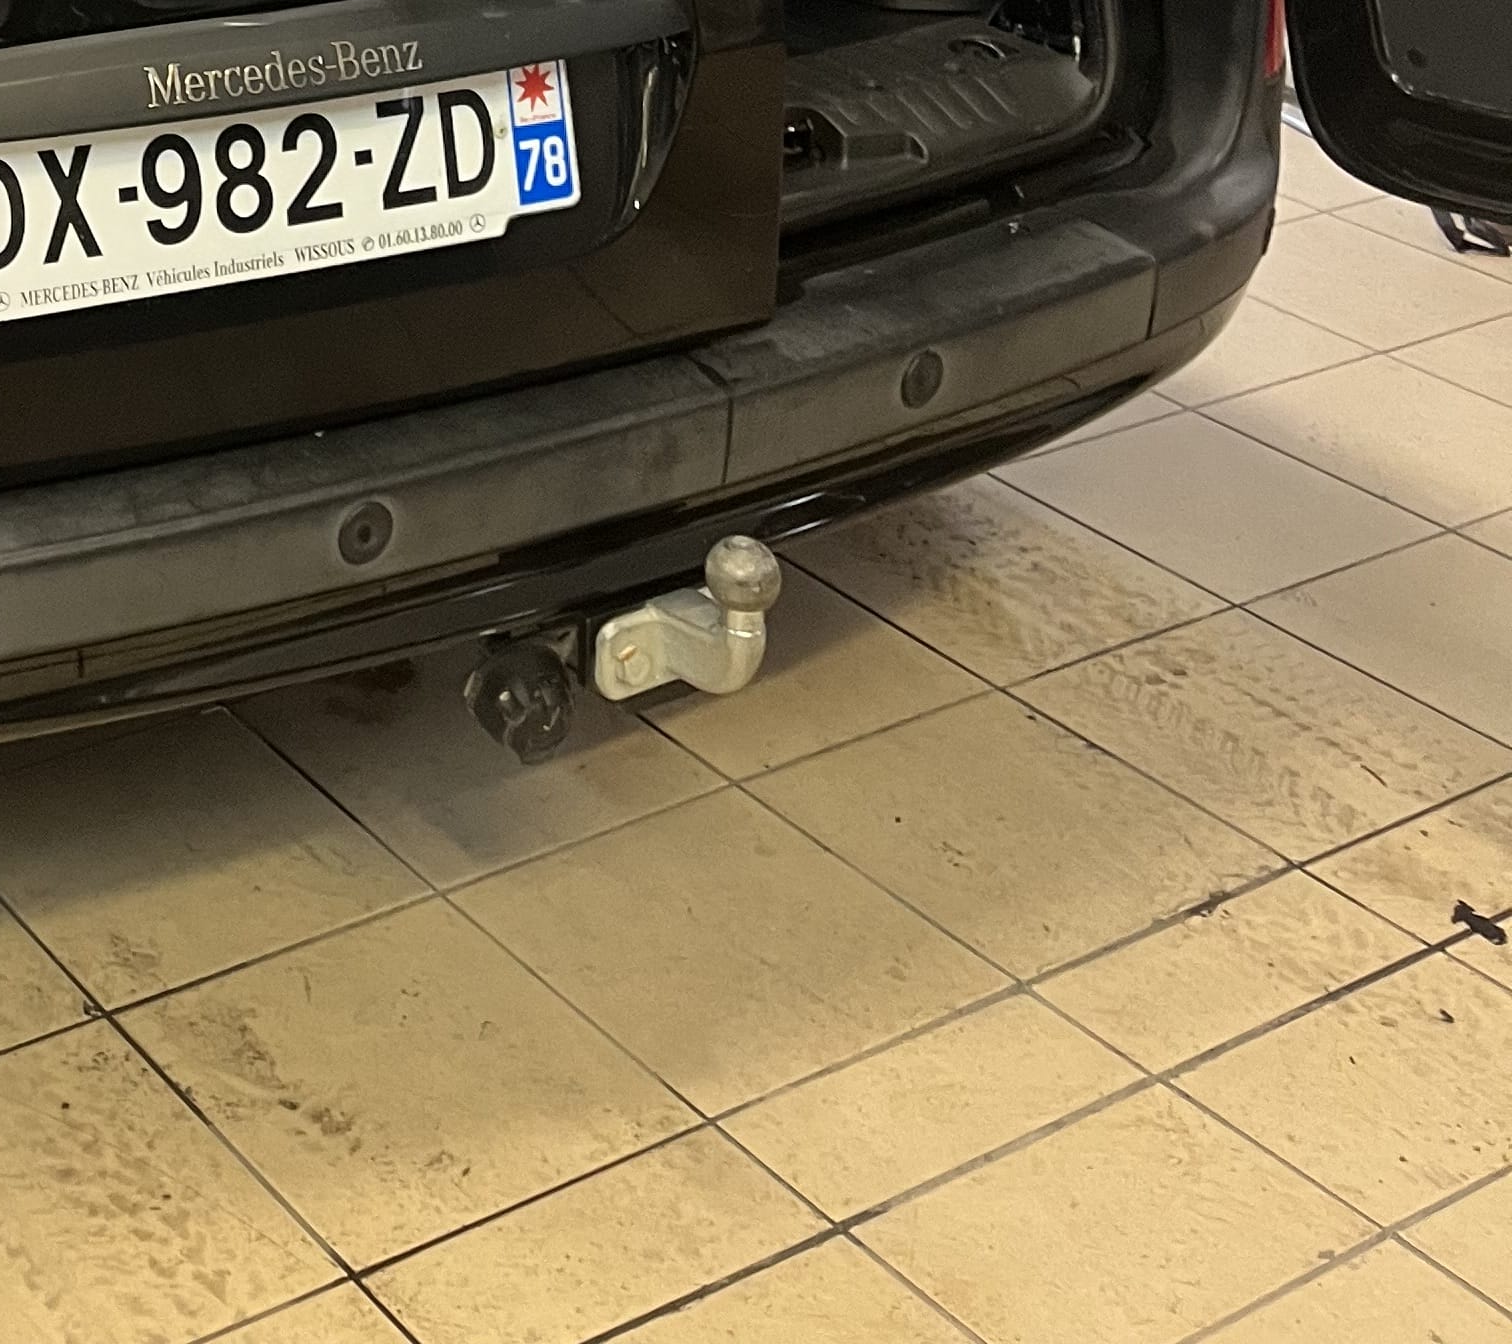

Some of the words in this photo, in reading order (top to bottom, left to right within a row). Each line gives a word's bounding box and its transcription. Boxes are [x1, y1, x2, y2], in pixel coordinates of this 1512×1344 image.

[144, 40, 423, 108] Mercedes-Benz
[519, 135, 568, 192] 78
[21, 274, 139, 308] MERCEDES-BENZ
[146, 263, 211, 288] Véhicules
[214, 251, 285, 277] Industriels
[294, 238, 355, 262] WISSOUS
[378, 220, 463, 250] 01.60.13.80.00
